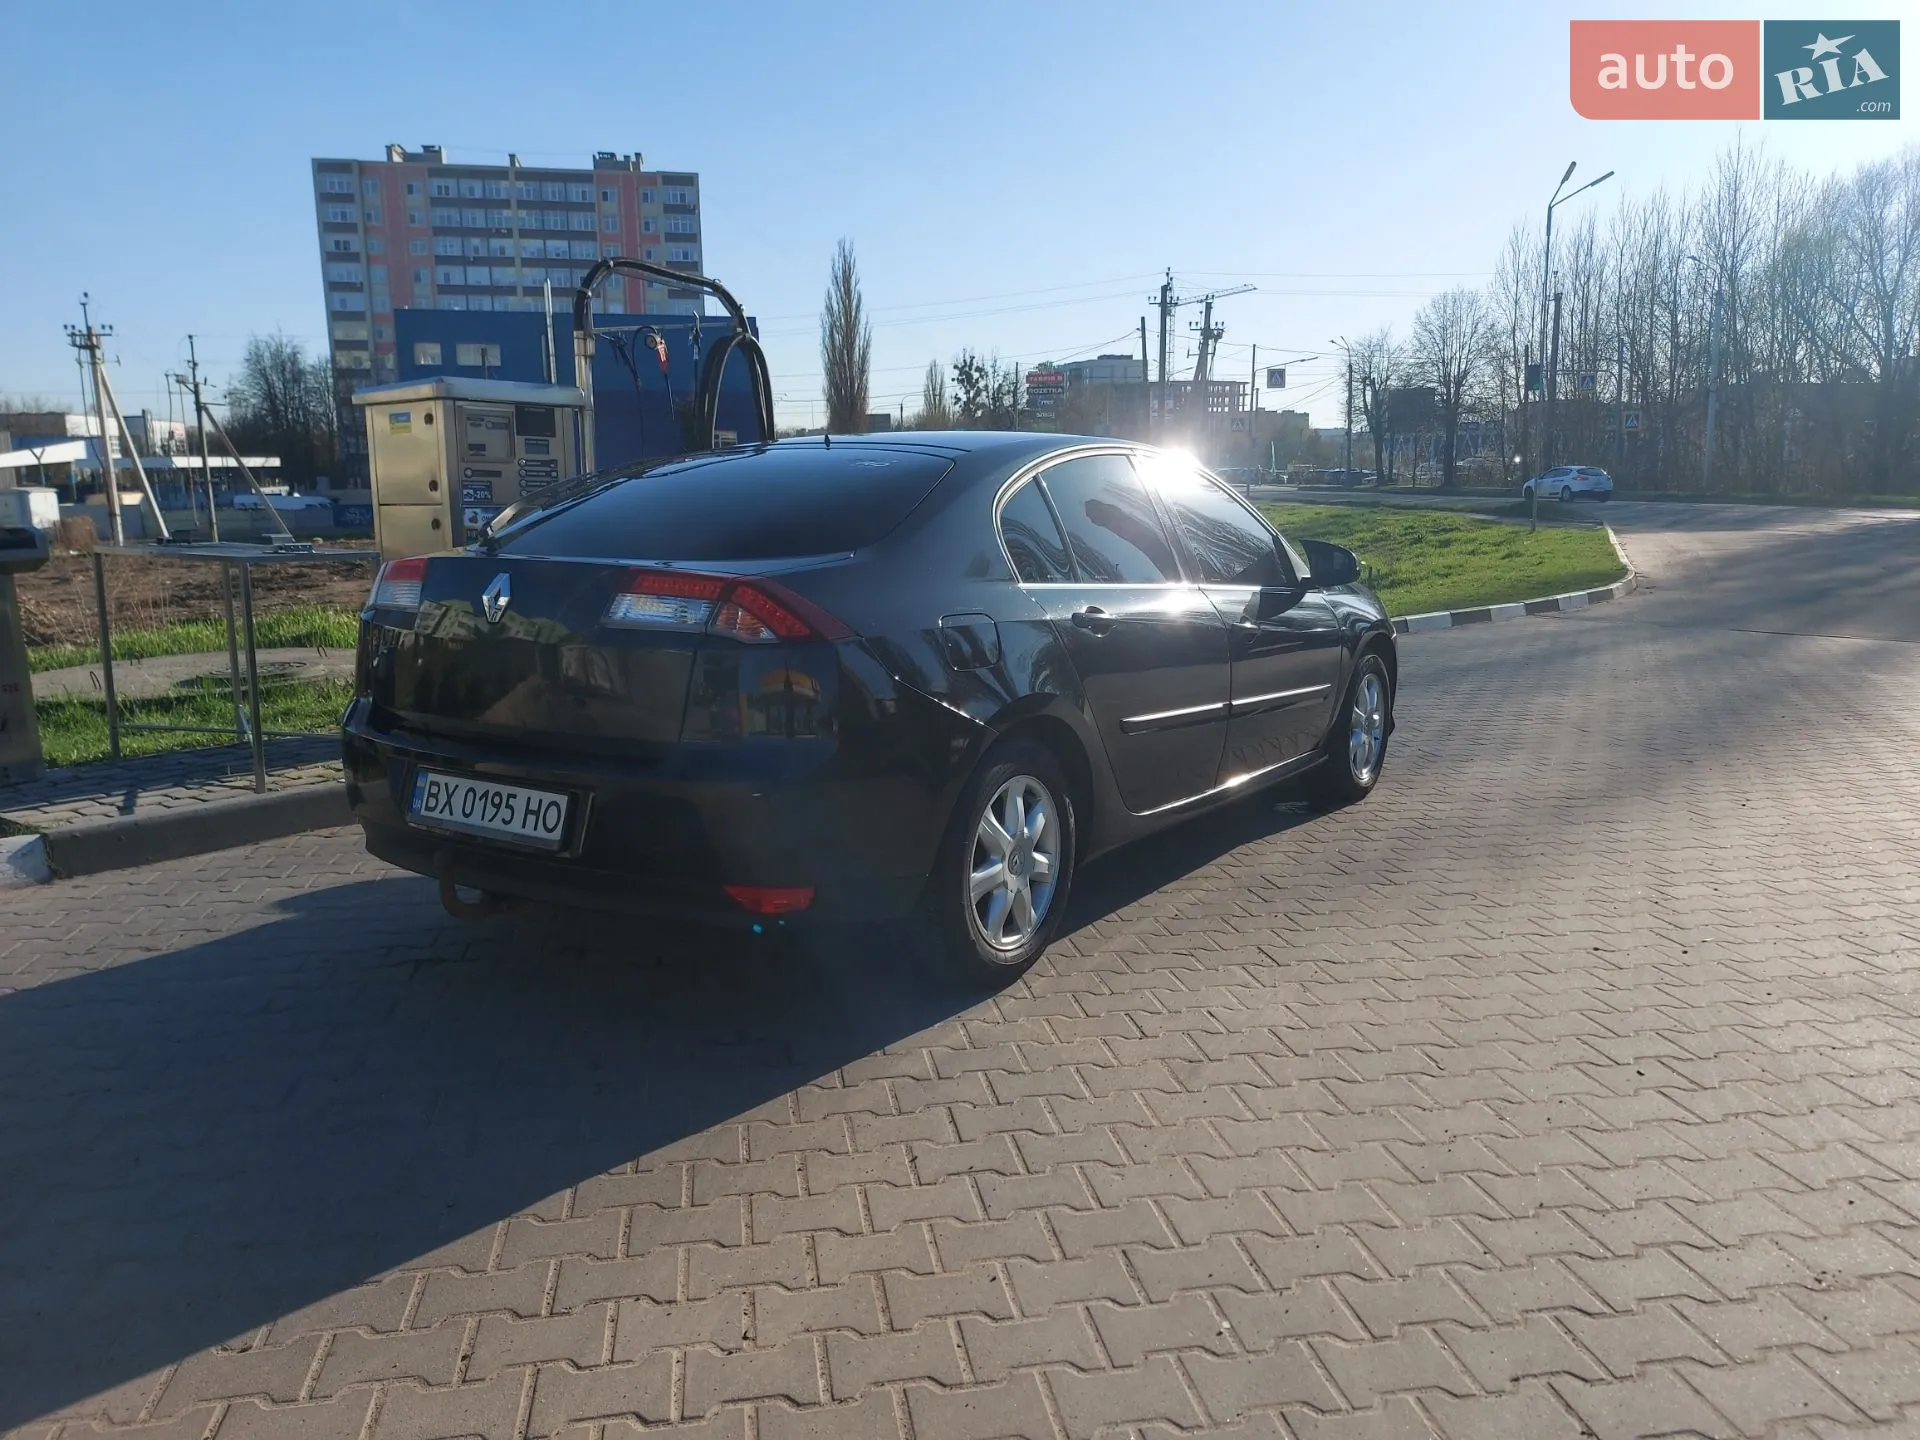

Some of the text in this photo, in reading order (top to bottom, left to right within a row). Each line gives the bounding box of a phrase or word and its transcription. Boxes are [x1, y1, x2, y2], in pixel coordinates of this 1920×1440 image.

[424, 779, 562, 834] BX 0195 HO
